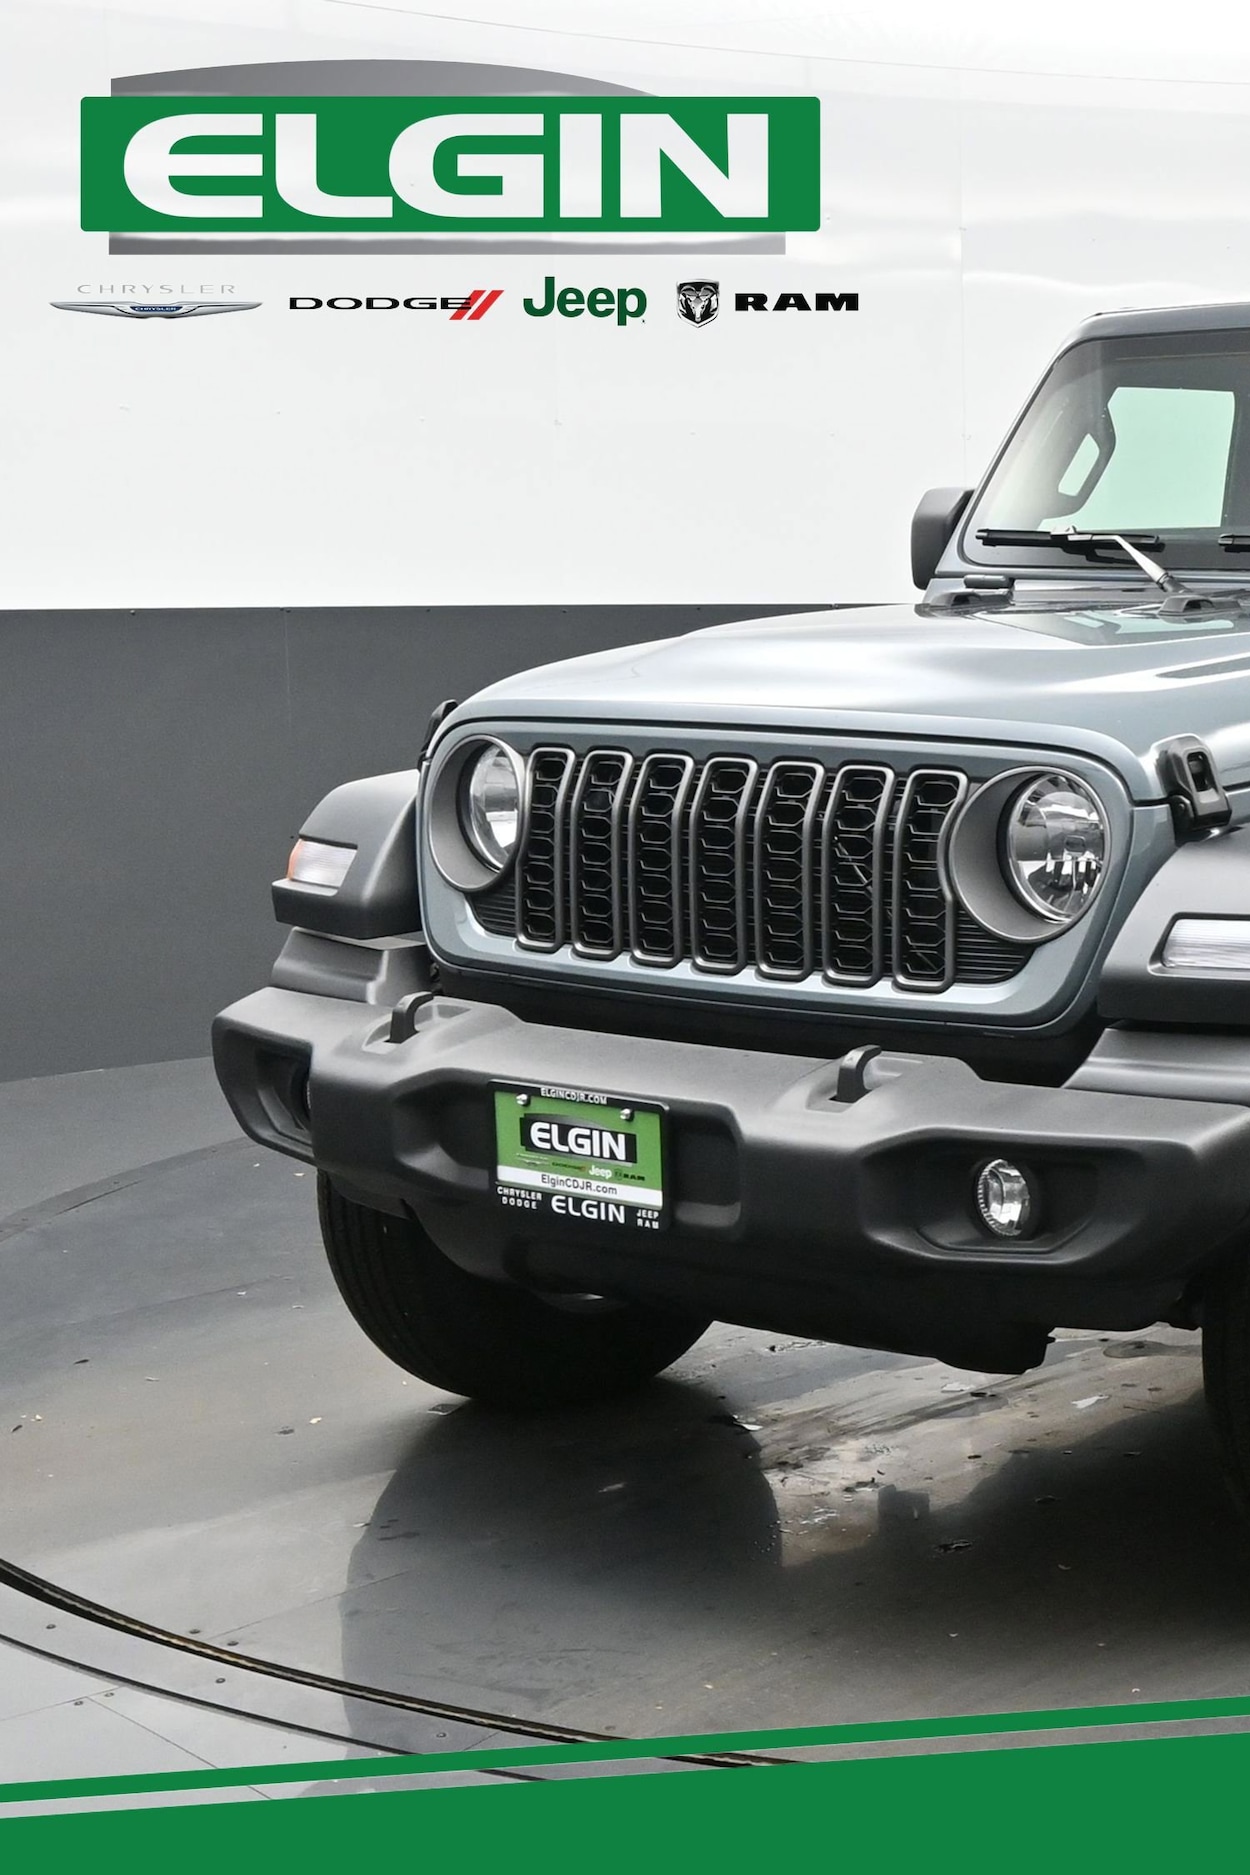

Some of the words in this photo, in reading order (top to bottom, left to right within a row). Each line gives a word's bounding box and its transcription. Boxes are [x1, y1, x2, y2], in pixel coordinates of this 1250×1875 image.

[541, 1087, 607, 1105] ELGINCDJR.COM
[530, 1121, 626, 1160] ELGIN
[589, 1165, 612, 1179] Jeep
[541, 1174, 617, 1195] ElginCDJR.com
[497, 1186, 542, 1200] CHRYSLER
[502, 1197, 537, 1209] DODGE
[551, 1195, 625, 1224] ELGIN
[636, 1209, 659, 1219] JEEP
[637, 1219, 659, 1229] RAM
